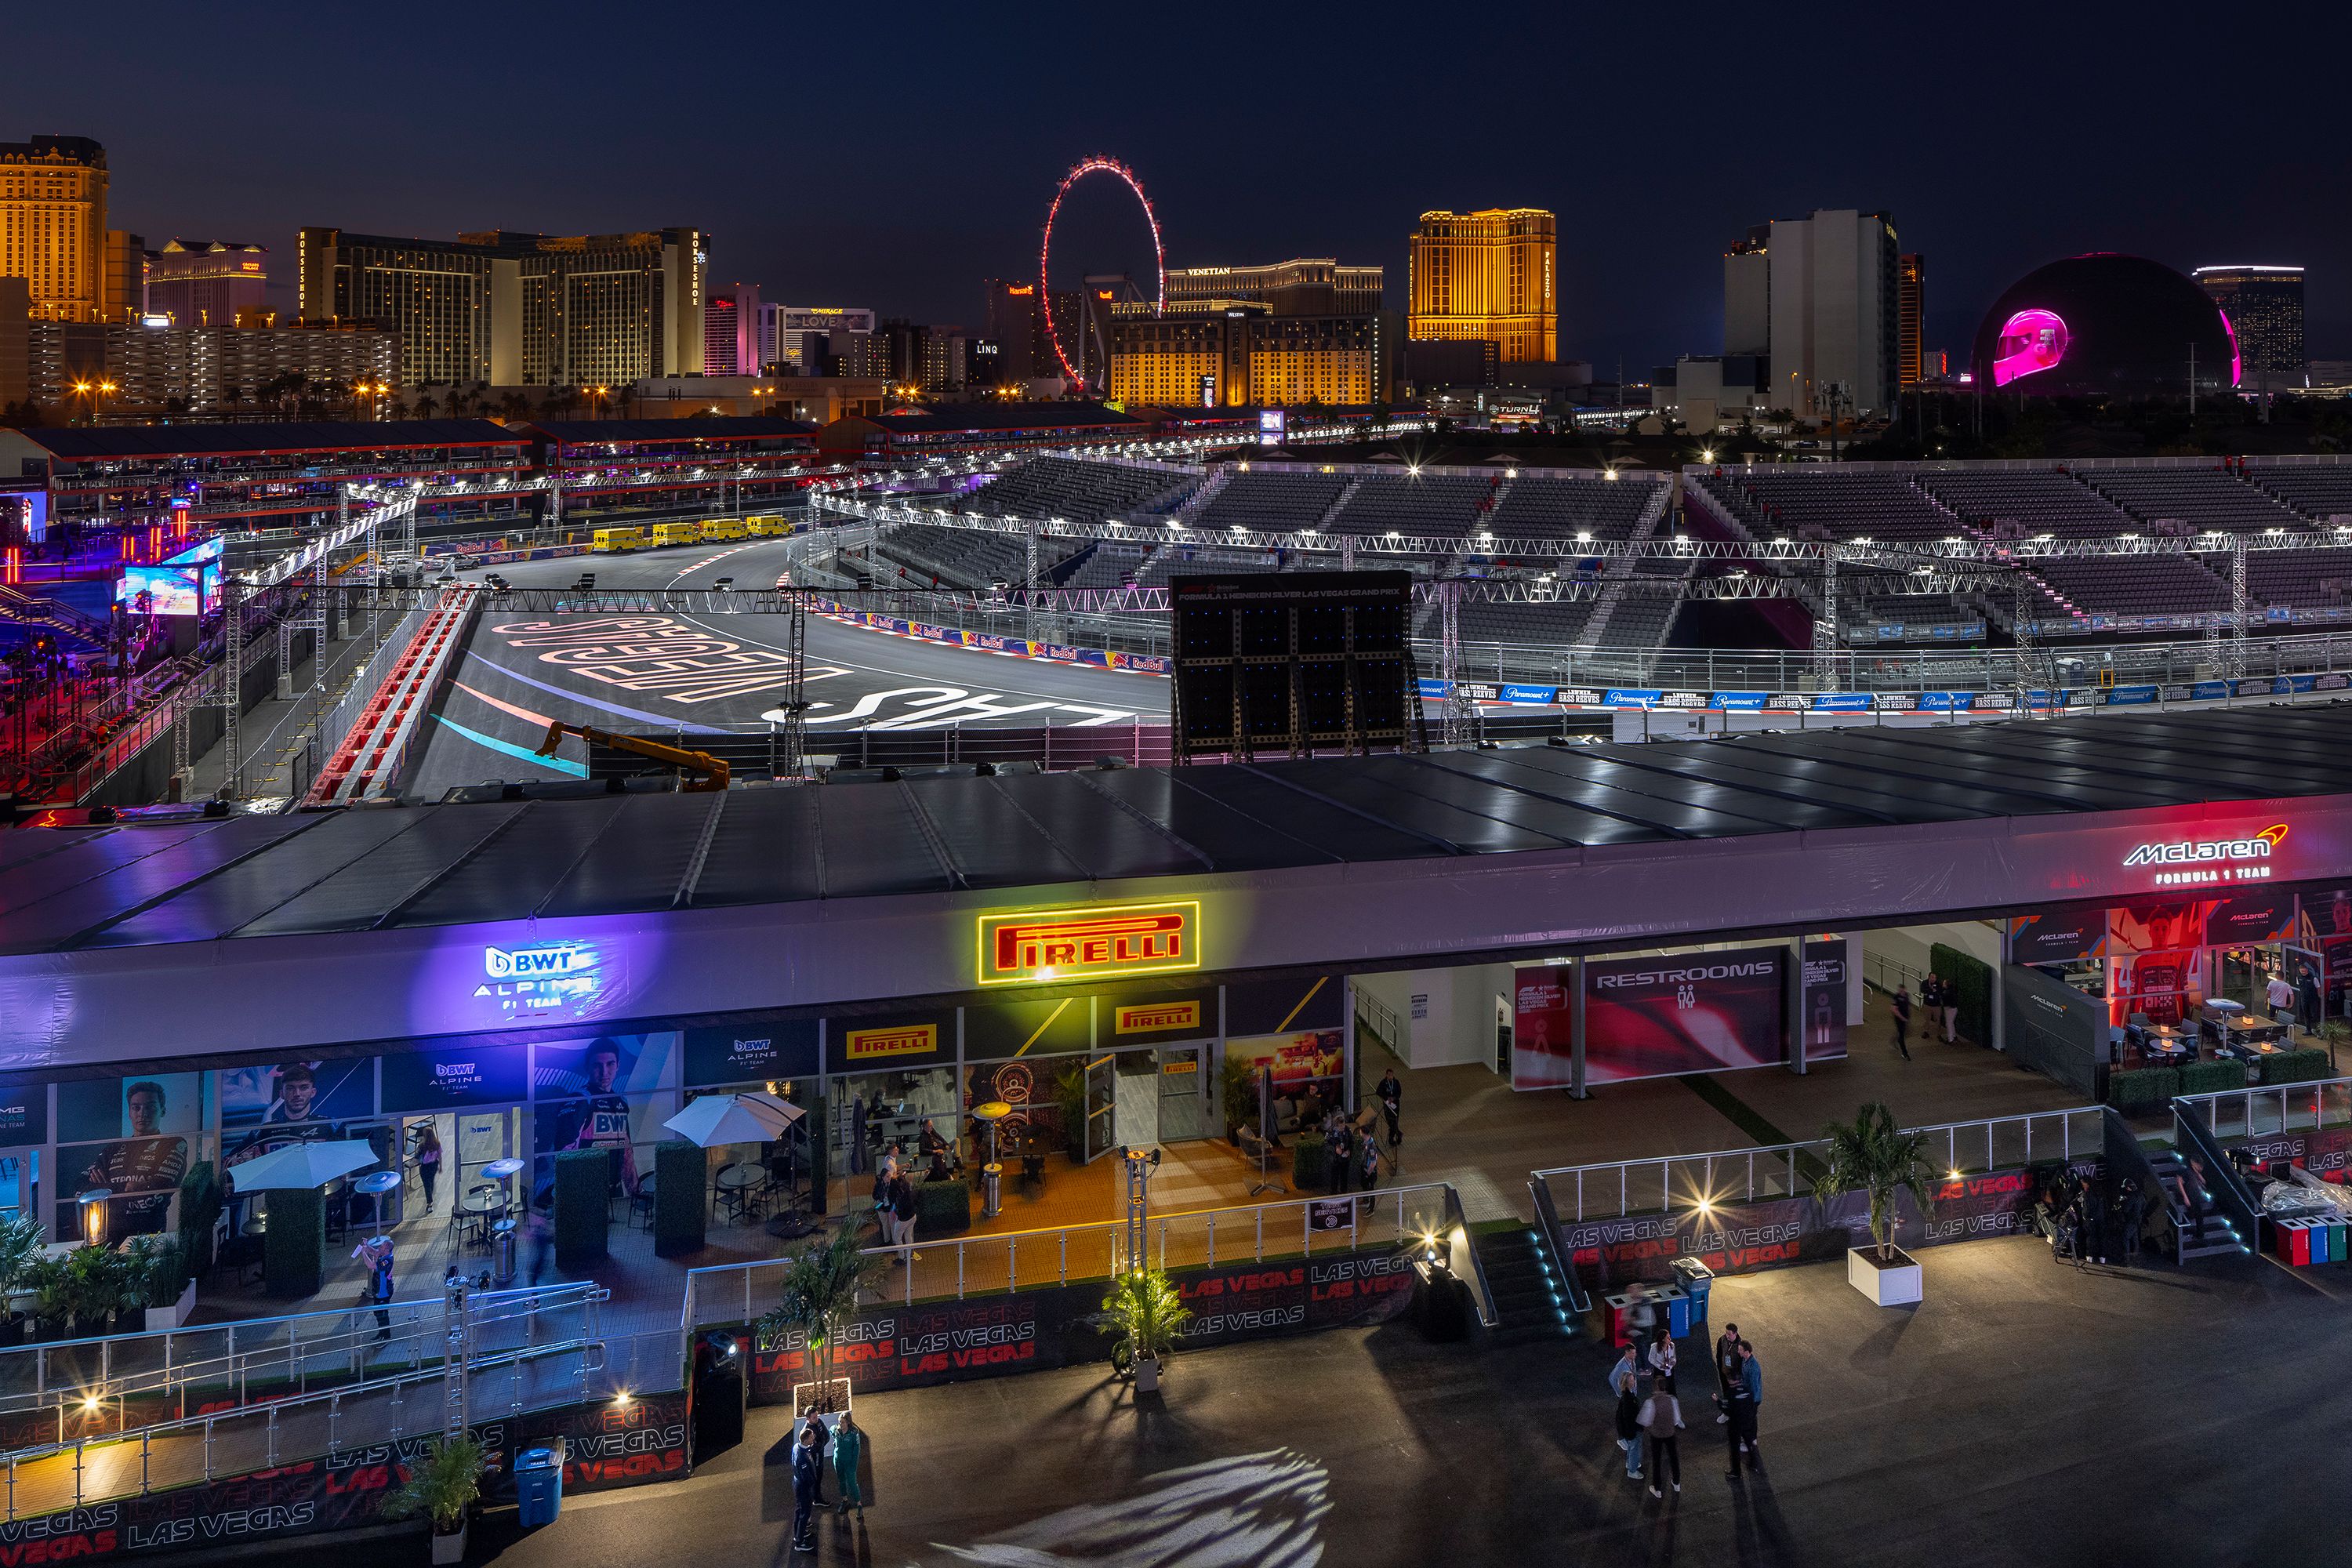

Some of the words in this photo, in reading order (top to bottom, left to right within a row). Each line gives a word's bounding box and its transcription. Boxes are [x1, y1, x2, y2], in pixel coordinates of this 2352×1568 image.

[1187, 267, 1231, 276] VENETIAN
[801, 316, 837, 328] LOVE
[977, 345, 998, 354] LINQ
[456, 543, 471, 553] Red
[472, 541, 485, 551] Bull
[553, 549, 564, 557] Red
[564, 546, 575, 556] Bull
[501, 554, 512, 562] Bull
[924, 627, 934, 637] Red
[934, 629, 942, 639] Bull
[981, 637, 992, 647] Red
[992, 638, 1004, 649] Bull
[1050, 647, 1063, 658] Red
[1064, 648, 1077, 660] Bull
[1133, 657, 1148, 669] Red
[1149, 659, 1164, 671] Bull
[1473, 691, 1497, 699] REEVES
[1505, 687, 1550, 699] Paramount+
[1559, 695, 1574, 703] BASS
[1575, 695, 1599, 704] REEVES
[1609, 691, 1654, 703] Paramount+
[2070, 696, 2085, 705] BASS
[1680, 699, 1705, 707] REEVES
[1769, 699, 1786, 708] BASS
[1892, 700, 1915, 709] REEVES
[1991, 698, 2013, 707] REEVES
[2122, 838, 2270, 866] McLaren
[2156, 871, 2218, 884] FORMULA
[2223, 870, 2230, 880] 1
[2237, 866, 2270, 879] TEAM
[2230, 913, 2269, 921] McLaren
[996, 913, 1184, 971] PIRELLI
[2037, 932, 2078, 942] McLaren
[515, 953, 572, 972] BWT
[1596, 961, 1773, 989] RESTROOMS
[2118, 956, 2132, 994] 4
[473, 978, 593, 997] ALPIN
[503, 1000, 517, 1010] F1
[525, 997, 562, 1009] TEAM
[2031, 994, 2063, 1012] McLaren
[1123, 1007, 1192, 1029] PIRELLI
[744, 1039, 771, 1050] BWT
[854, 1030, 929, 1053] PIRELLI
[728, 1051, 778, 1061] ALPINE
[447, 1063, 475, 1075] BWT
[1166, 1063, 1194, 1073] PIRELLI
[429, 1076, 482, 1086] ALPINE
[2309, 1152, 2345, 1171] LAS
[1967, 1173, 2033, 1196] VEGAS
[129, 1193, 164, 1210] INEOS
[1320, 1202, 1342, 1210] TEAM
[1315, 1207, 1348, 1218] SERVICES
[1601, 1218, 1677, 1243] VEGAS
[1926, 1218, 1964, 1239] LAS
[1967, 1210, 2035, 1232] VEGAS
[1683, 1232, 1726, 1253] LAS
[1727, 1222, 1800, 1247] VEGAS
[1603, 1239, 1677, 1262] VEGAS
[1729, 1241, 1800, 1267] VEGAS
[1312, 1261, 1355, 1283] LAS
[1180, 1277, 1224, 1299] LAS
[1228, 1269, 1304, 1292] VEGAS
[1312, 1280, 1354, 1301] LAS
[1179, 1315, 1225, 1337] LAS
[1227, 1305, 1305, 1330] VEGAS
[756, 1330, 805, 1353] LAS
[901, 1333, 949, 1356] LAS
[952, 1321, 1035, 1348] VEGAS
[756, 1351, 804, 1374] LAS
[902, 1352, 949, 1375] LAS
[952, 1341, 1035, 1369] VEGAS
[579, 1425, 684, 1459] VEGAS
[326, 1446, 390, 1470] LAS
[579, 1450, 684, 1483] VEGAS
[326, 1465, 389, 1494] LAS
[0, 1504, 118, 1542] VEGAS
[128, 1518, 194, 1549] LAS
[199, 1501, 314, 1537] VEGAS
[0, 1530, 118, 1568] VEGAS
